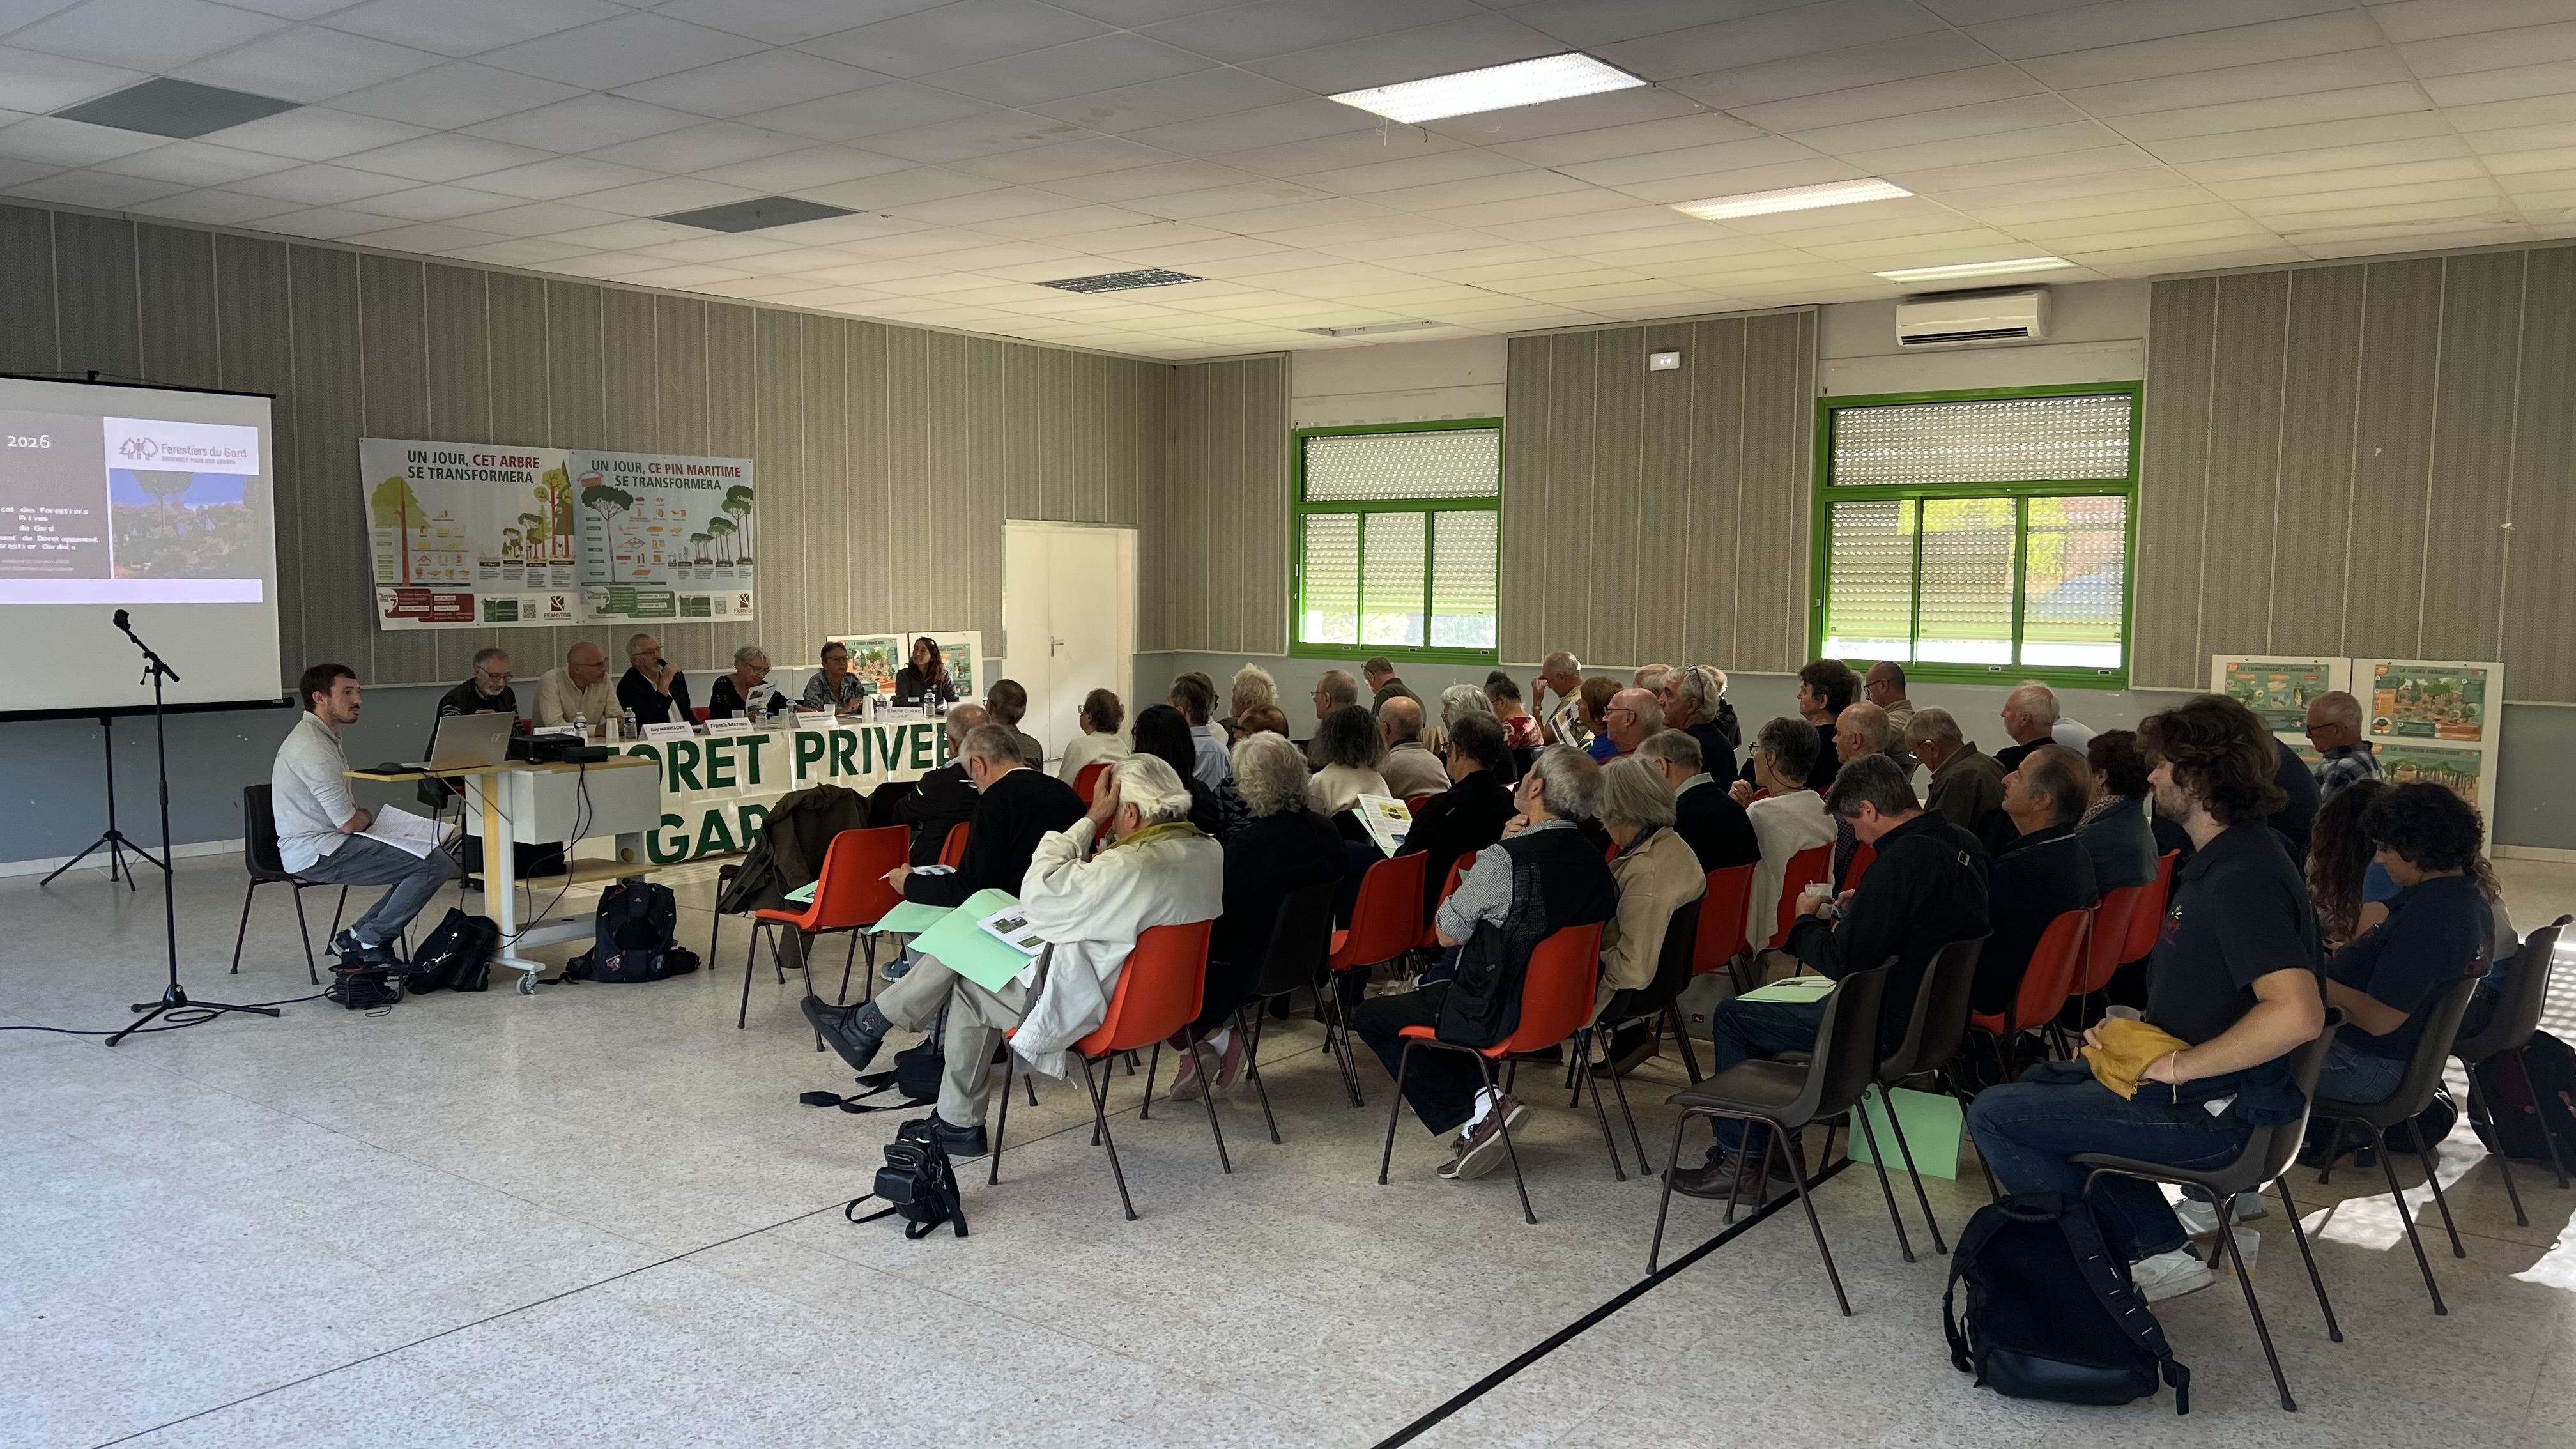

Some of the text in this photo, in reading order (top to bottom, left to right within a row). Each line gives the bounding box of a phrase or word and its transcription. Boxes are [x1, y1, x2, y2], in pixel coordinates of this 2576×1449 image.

[7, 434, 50, 448] 2026
[161, 443, 248, 458] Forestiers du Gard
[408, 450, 540, 469] UN JOUR, CET ARBRE
[408, 466, 533, 484] SE TRANSFORMERA
[591, 459, 741, 477] UN JOUR, CE PIN MARITIME
[615, 475, 629, 487] SE
[632, 476, 722, 491] TRANSFORMERA
[607, 734, 770, 793] RET
